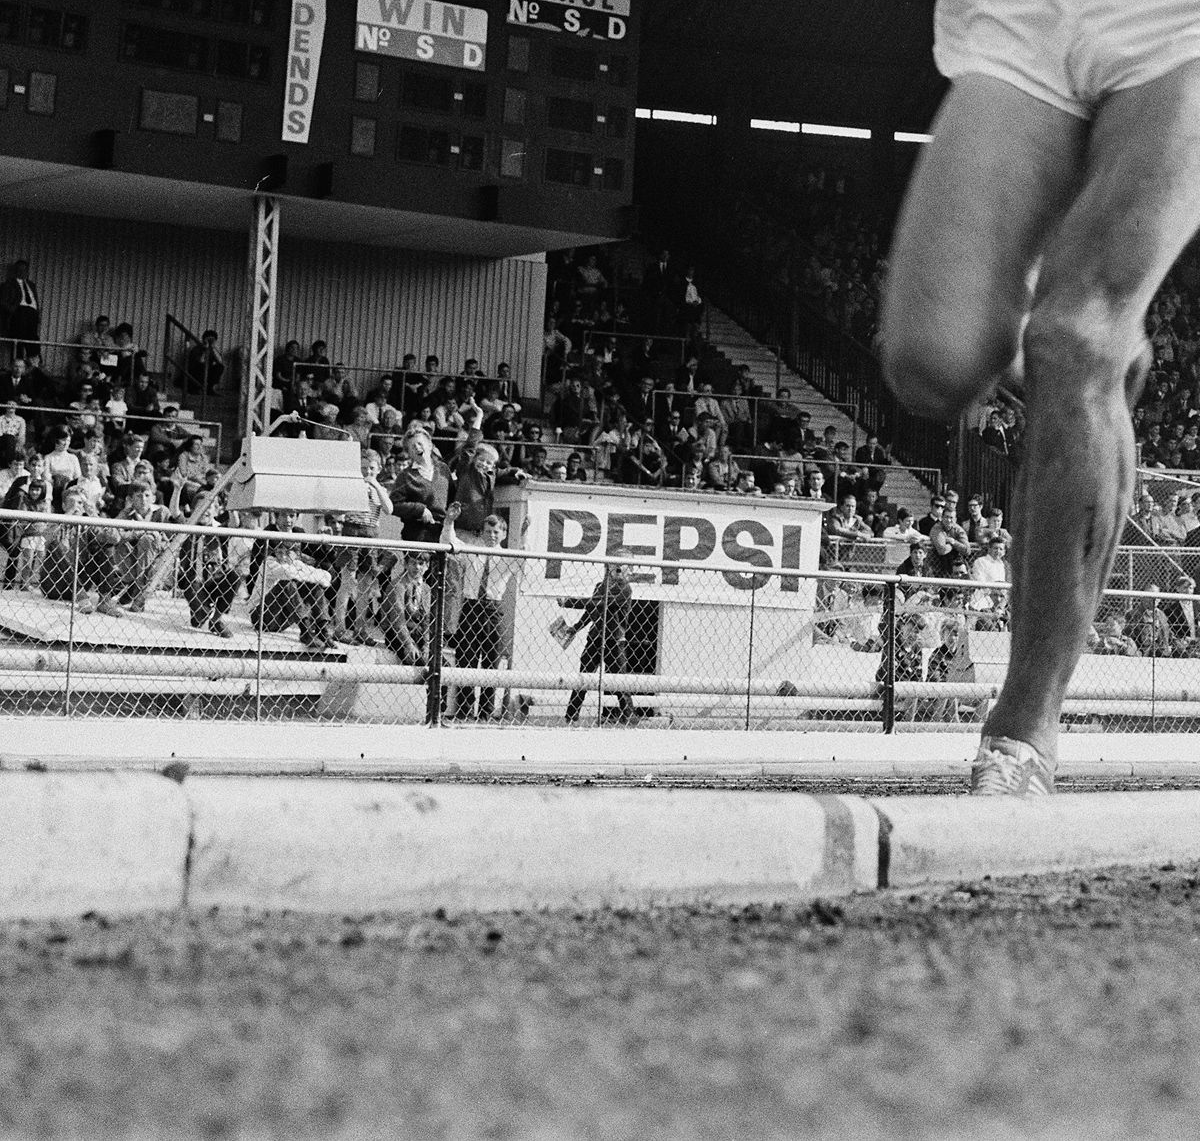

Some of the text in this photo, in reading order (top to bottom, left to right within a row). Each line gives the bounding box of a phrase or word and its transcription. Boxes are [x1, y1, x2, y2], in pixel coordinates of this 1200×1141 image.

[563, 8, 582, 34] S
[607, 16, 627, 40] D
[416, 34, 436, 60] S
[463, 42, 485, 68] D
[544, 508, 803, 593] PEPSI
